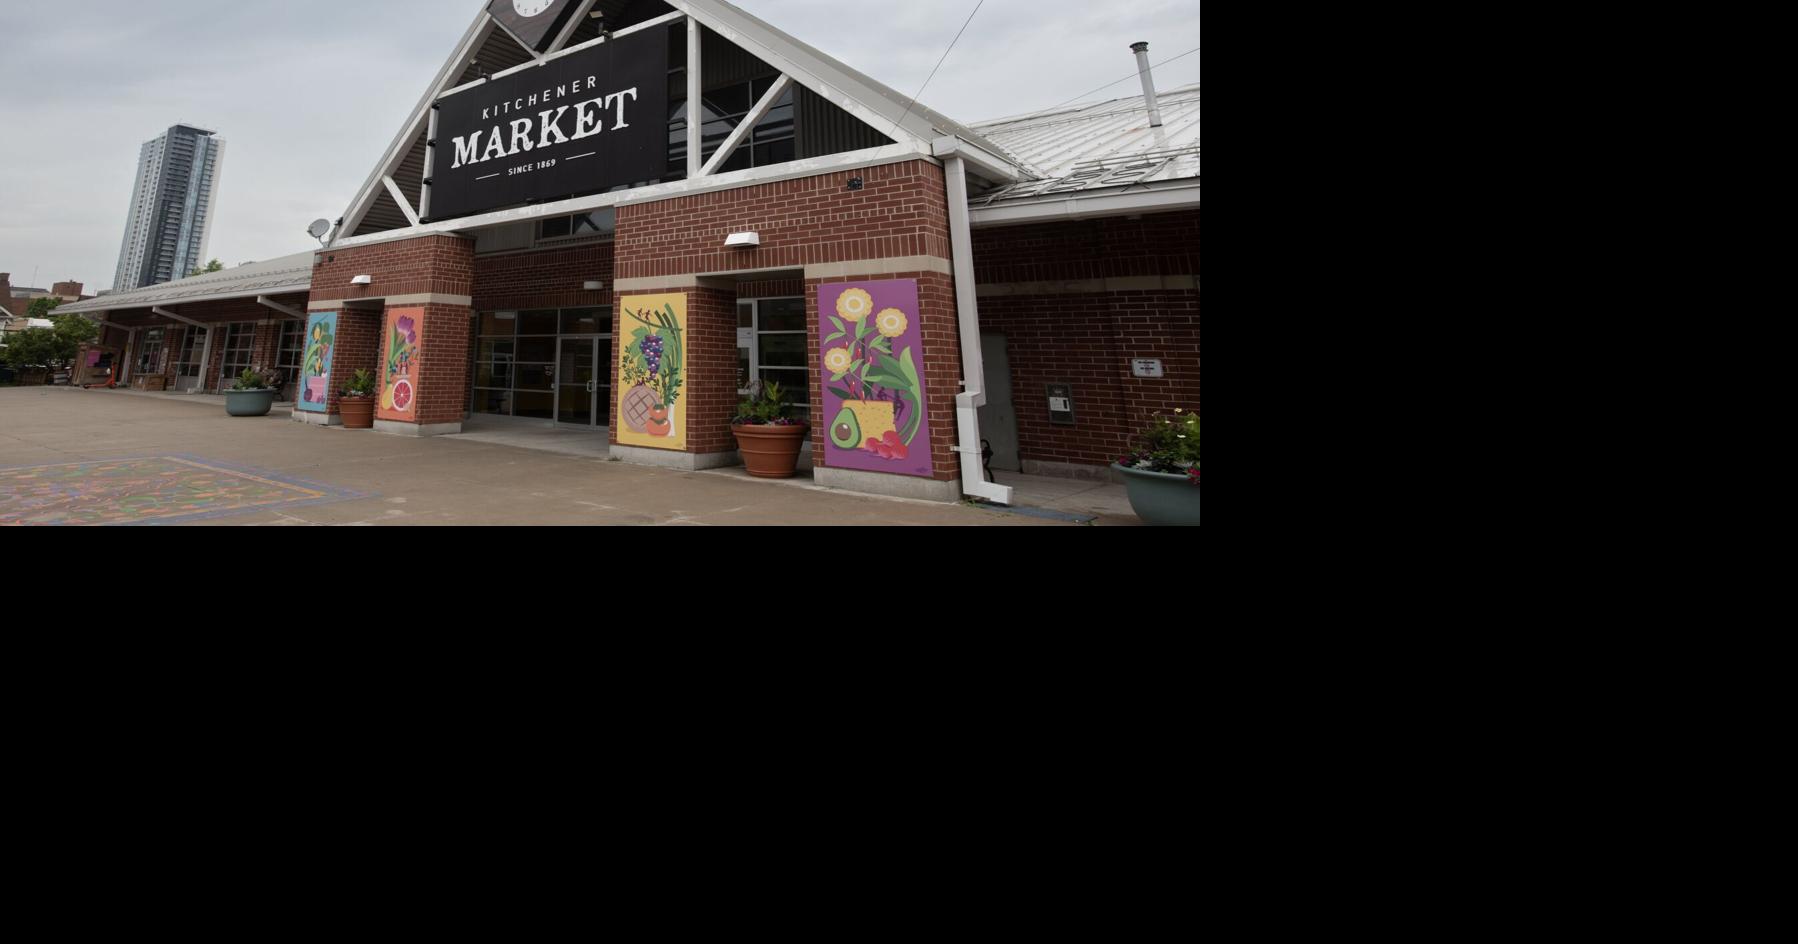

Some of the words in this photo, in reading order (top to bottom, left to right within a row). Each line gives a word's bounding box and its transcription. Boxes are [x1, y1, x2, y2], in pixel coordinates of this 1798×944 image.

[482, 75, 596, 120] KITCHENER
[450, 87, 638, 169] MARKET
[508, 163, 533, 176] SINCE
[536, 158, 556, 170] 1869
